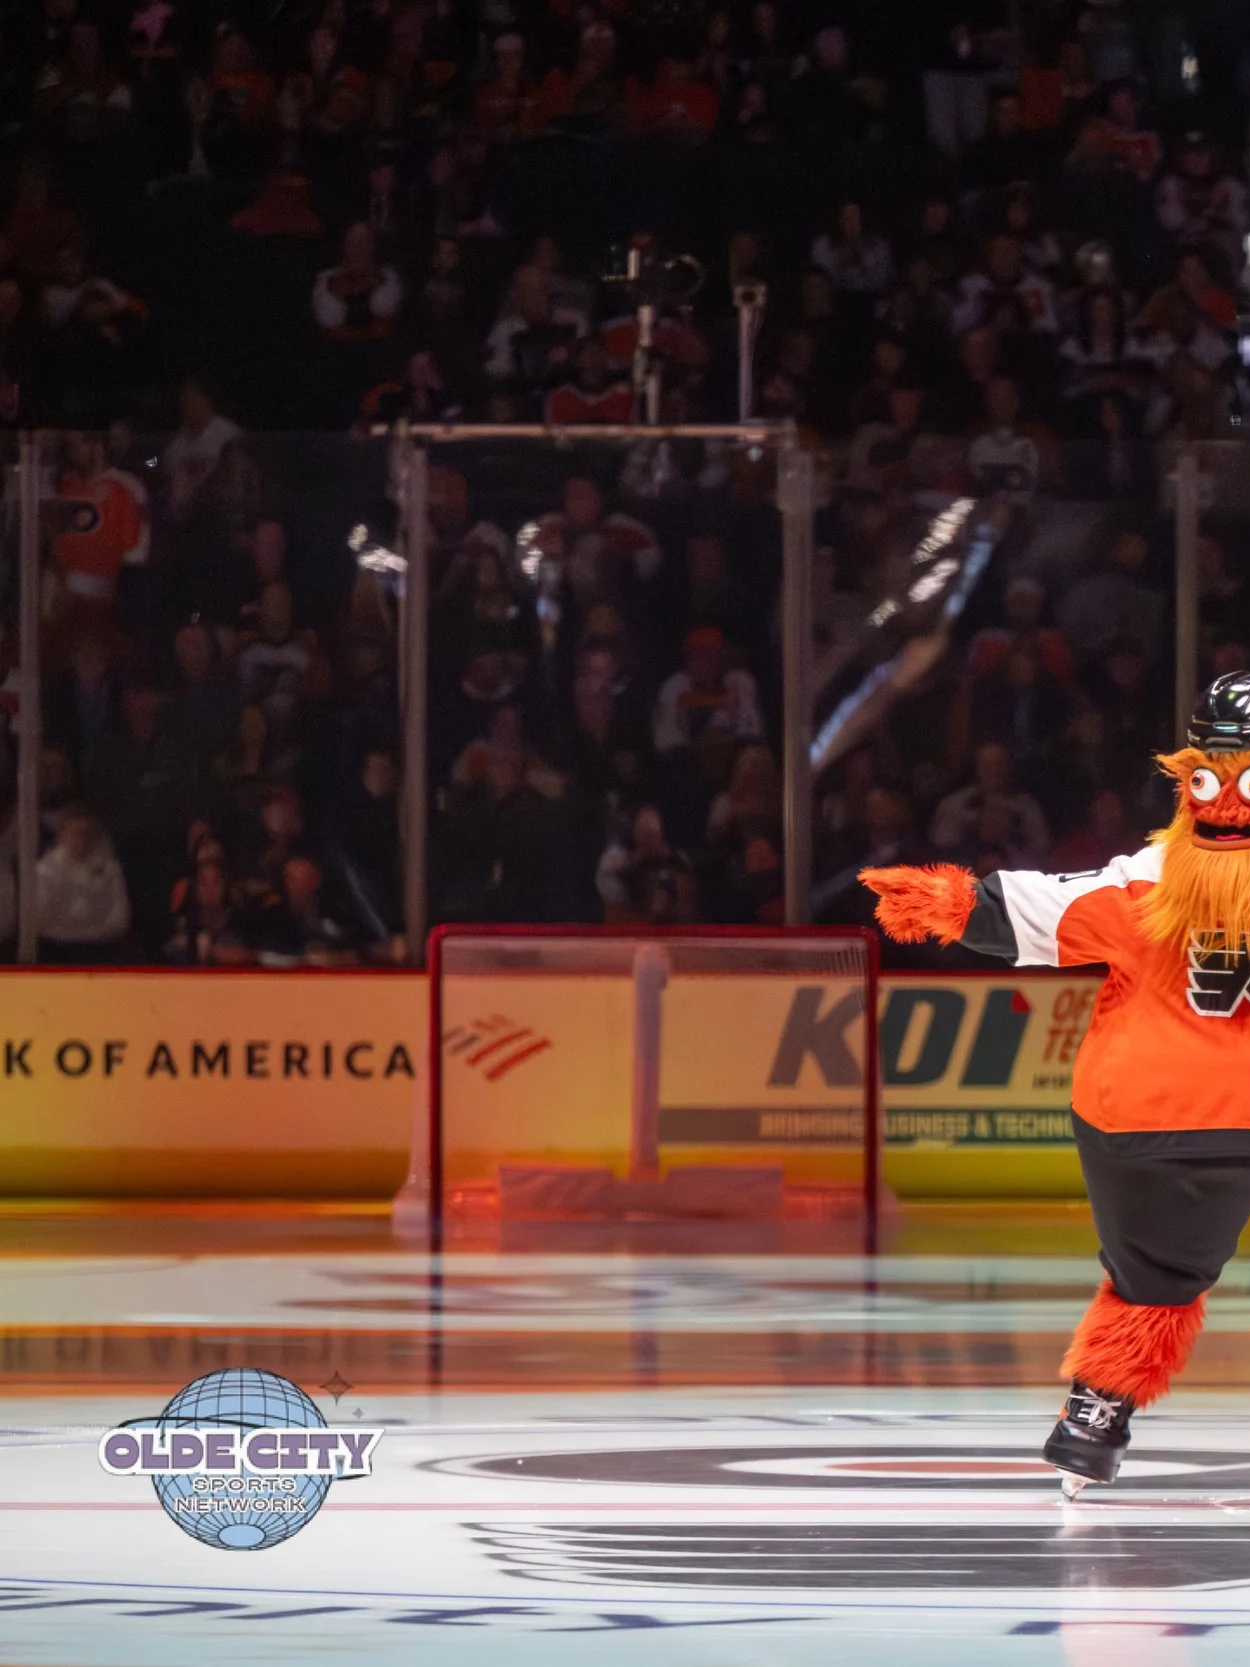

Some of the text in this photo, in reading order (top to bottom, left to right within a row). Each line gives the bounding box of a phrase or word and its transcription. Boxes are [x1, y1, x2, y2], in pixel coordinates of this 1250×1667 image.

[1053, 986, 1095, 1023] OF
[766, 985, 1034, 1089] KDI
[1043, 1028, 1077, 1064] TE
[55, 1040, 127, 1077] OF
[147, 1040, 417, 1078] AMERICA
